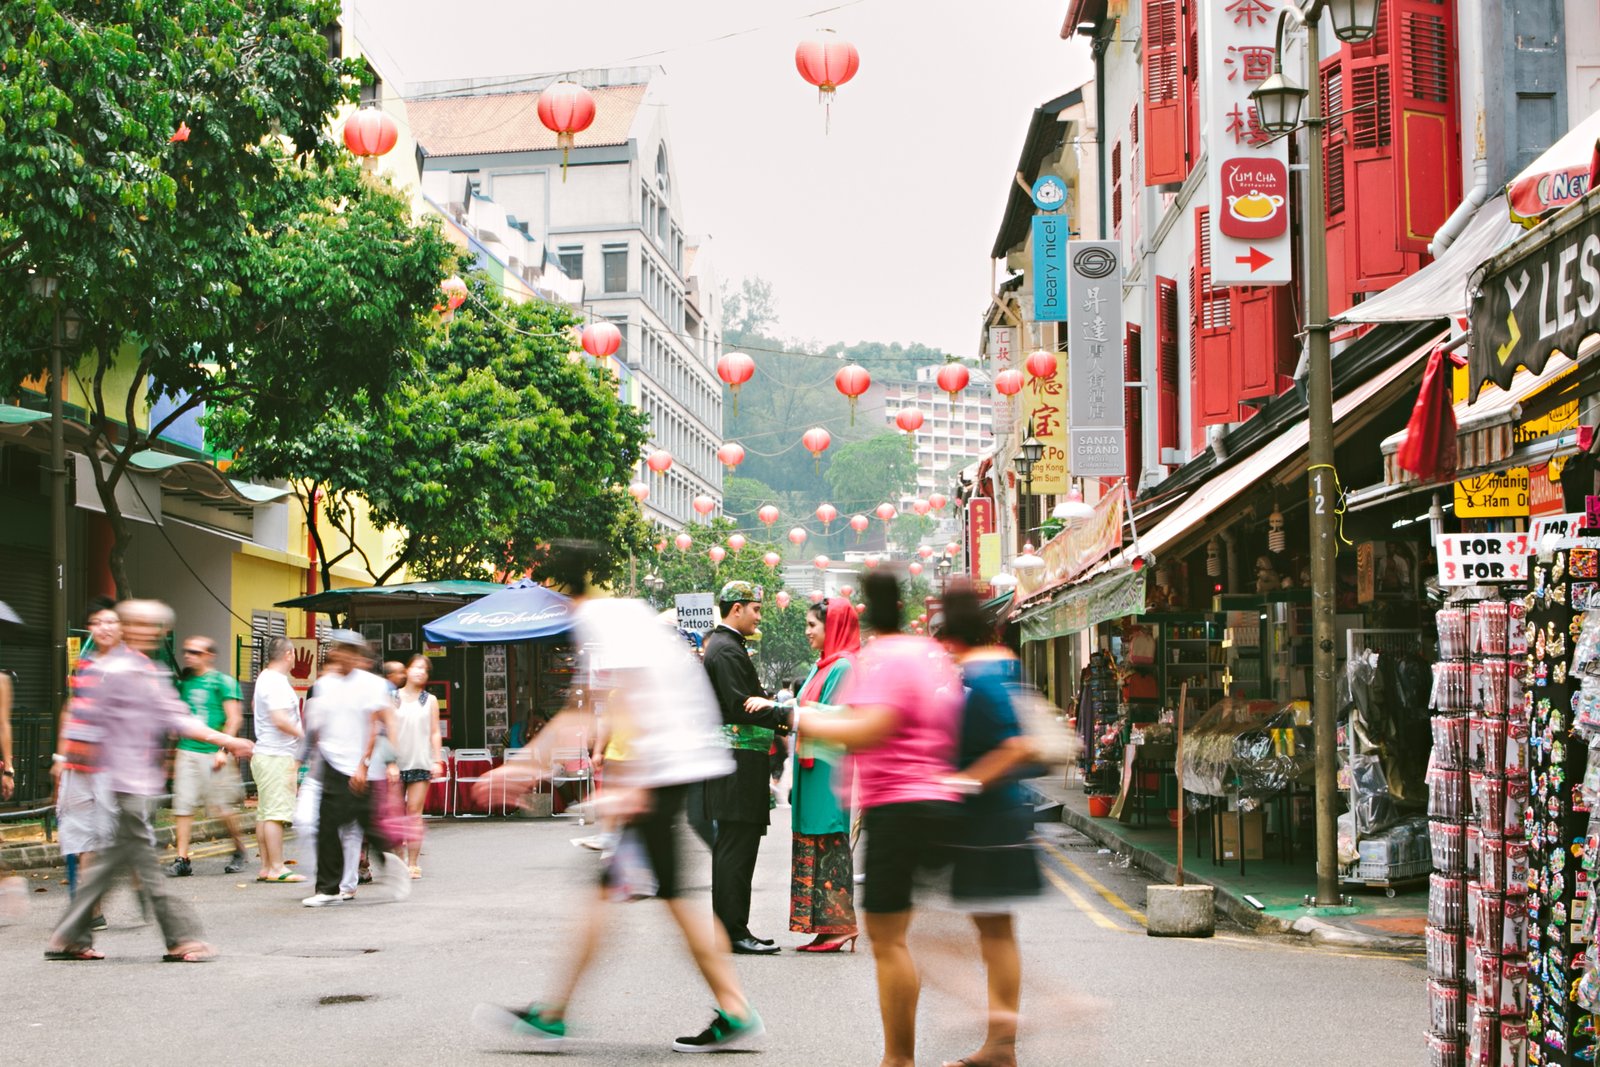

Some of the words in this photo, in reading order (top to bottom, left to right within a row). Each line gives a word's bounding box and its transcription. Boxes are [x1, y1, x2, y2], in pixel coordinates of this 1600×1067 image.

[1255, 171, 1277, 182] CHA
[1042, 219, 1057, 259] nice!
[1043, 263, 1061, 308] beary
[1079, 436, 1117, 445] SANTA
[1048, 446, 1064, 460] Po
[1077, 445, 1119, 455] GRAND
[1046, 463, 1064, 473] Kong
[1045, 474, 1060, 482] Sum
[1313, 474, 1325, 514] 12
[1533, 520, 1542, 541] 1
[1443, 538, 1453, 556] 1
[1460, 538, 1502, 556] FOR
[1445, 562, 1456, 580] 3
[1463, 562, 1505, 579] FOR
[677, 606, 713, 617] Henna
[678, 618, 715, 629] Tattoos
